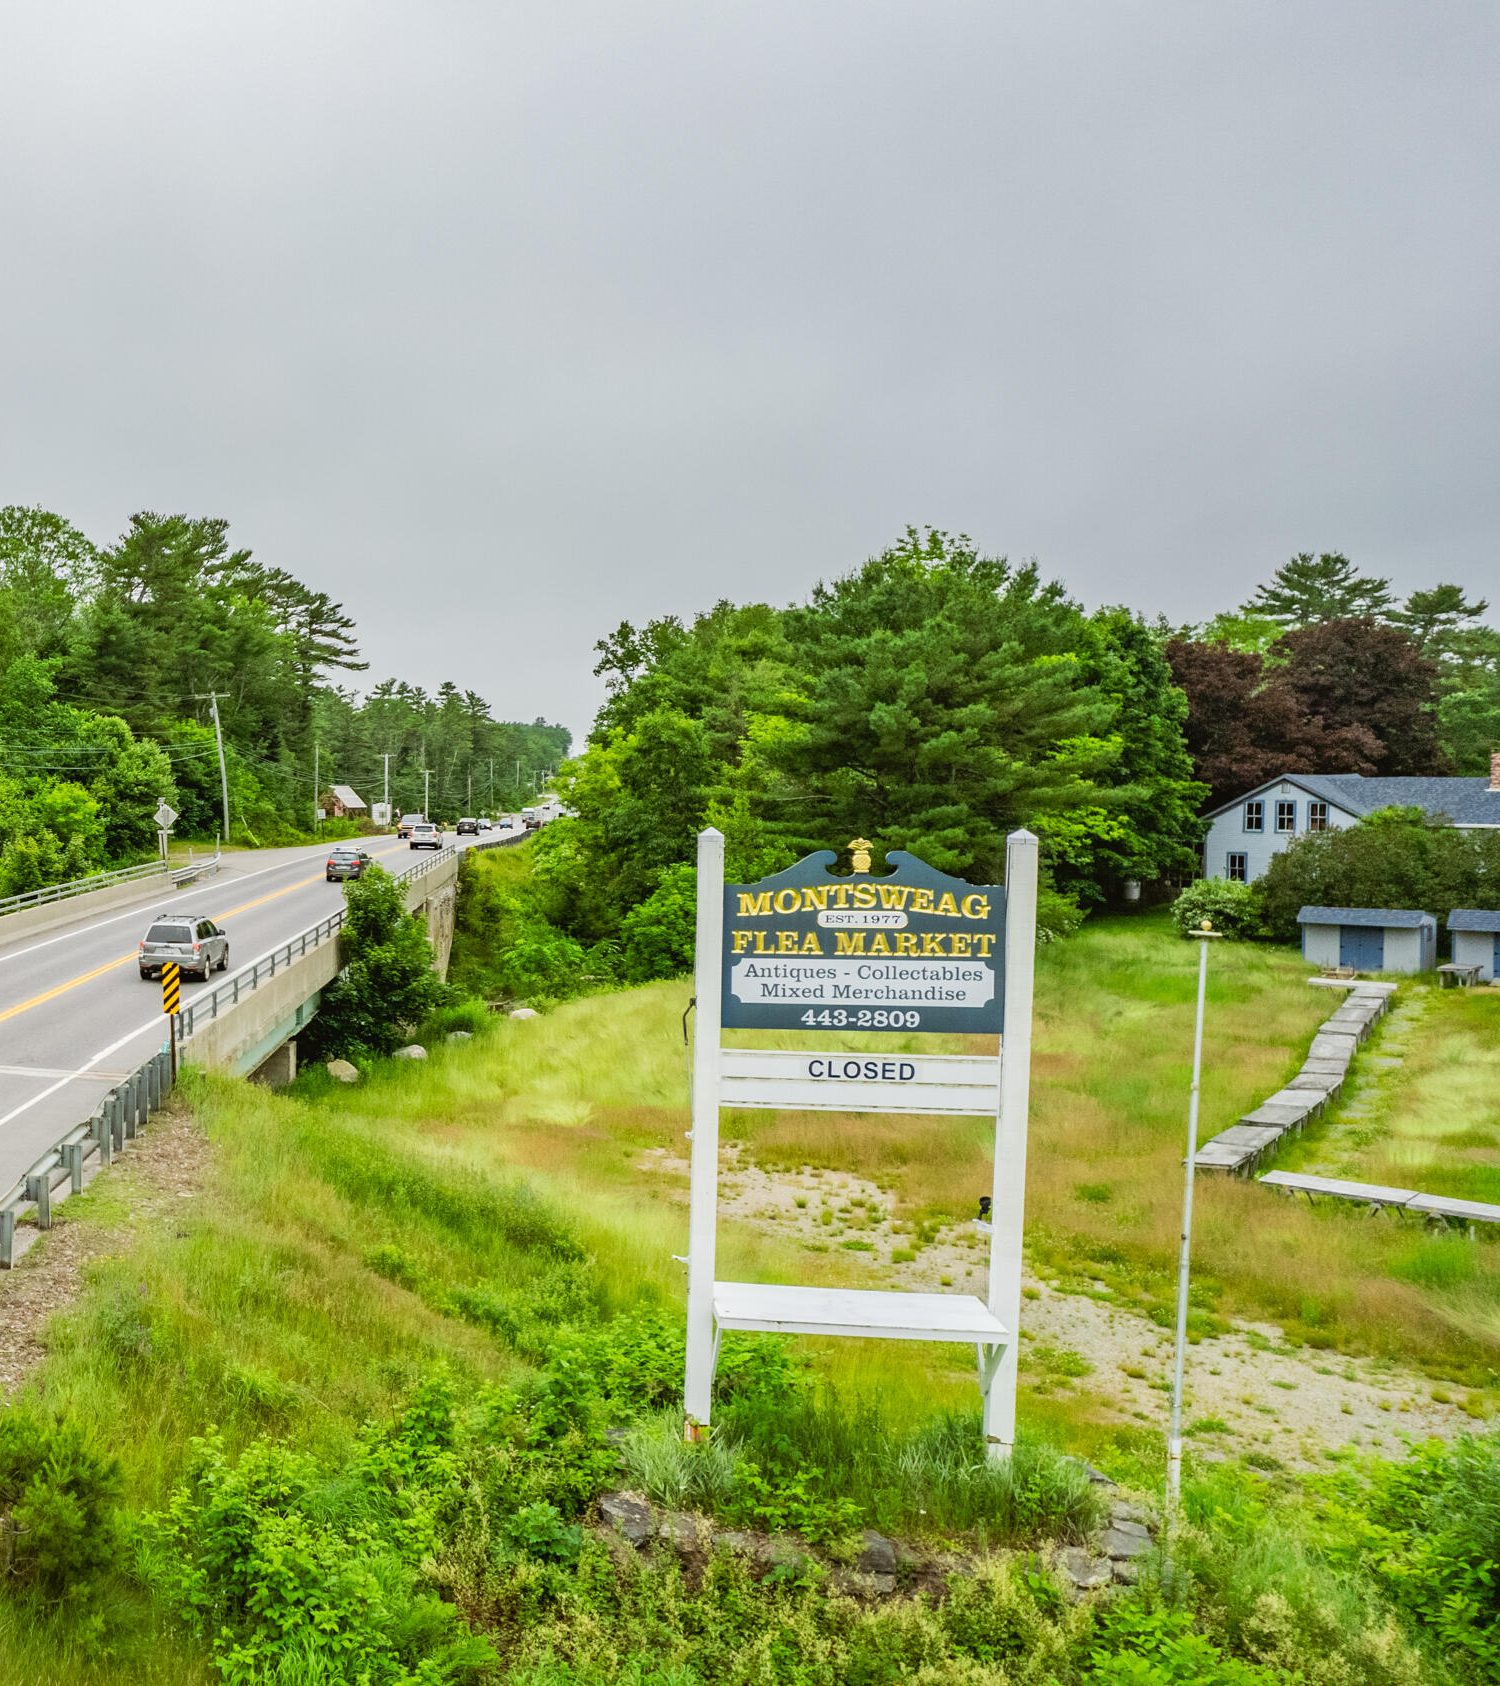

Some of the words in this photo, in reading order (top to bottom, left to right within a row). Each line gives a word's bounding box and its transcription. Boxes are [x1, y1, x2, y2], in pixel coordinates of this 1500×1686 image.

[736, 883, 992, 920] MONTSWEAG
[825, 914, 858, 924] EST.
[862, 914, 901, 924] 1977
[731, 930, 824, 955] FLEA
[834, 932, 996, 958] MARKET
[744, 963, 837, 981] Antiques
[857, 965, 983, 982] Collectables
[760, 983, 825, 999] Mixed
[832, 985, 967, 1001] Merchandise
[800, 1009, 921, 1028] 443-2809
[808, 1059, 916, 1081] CLOSED
